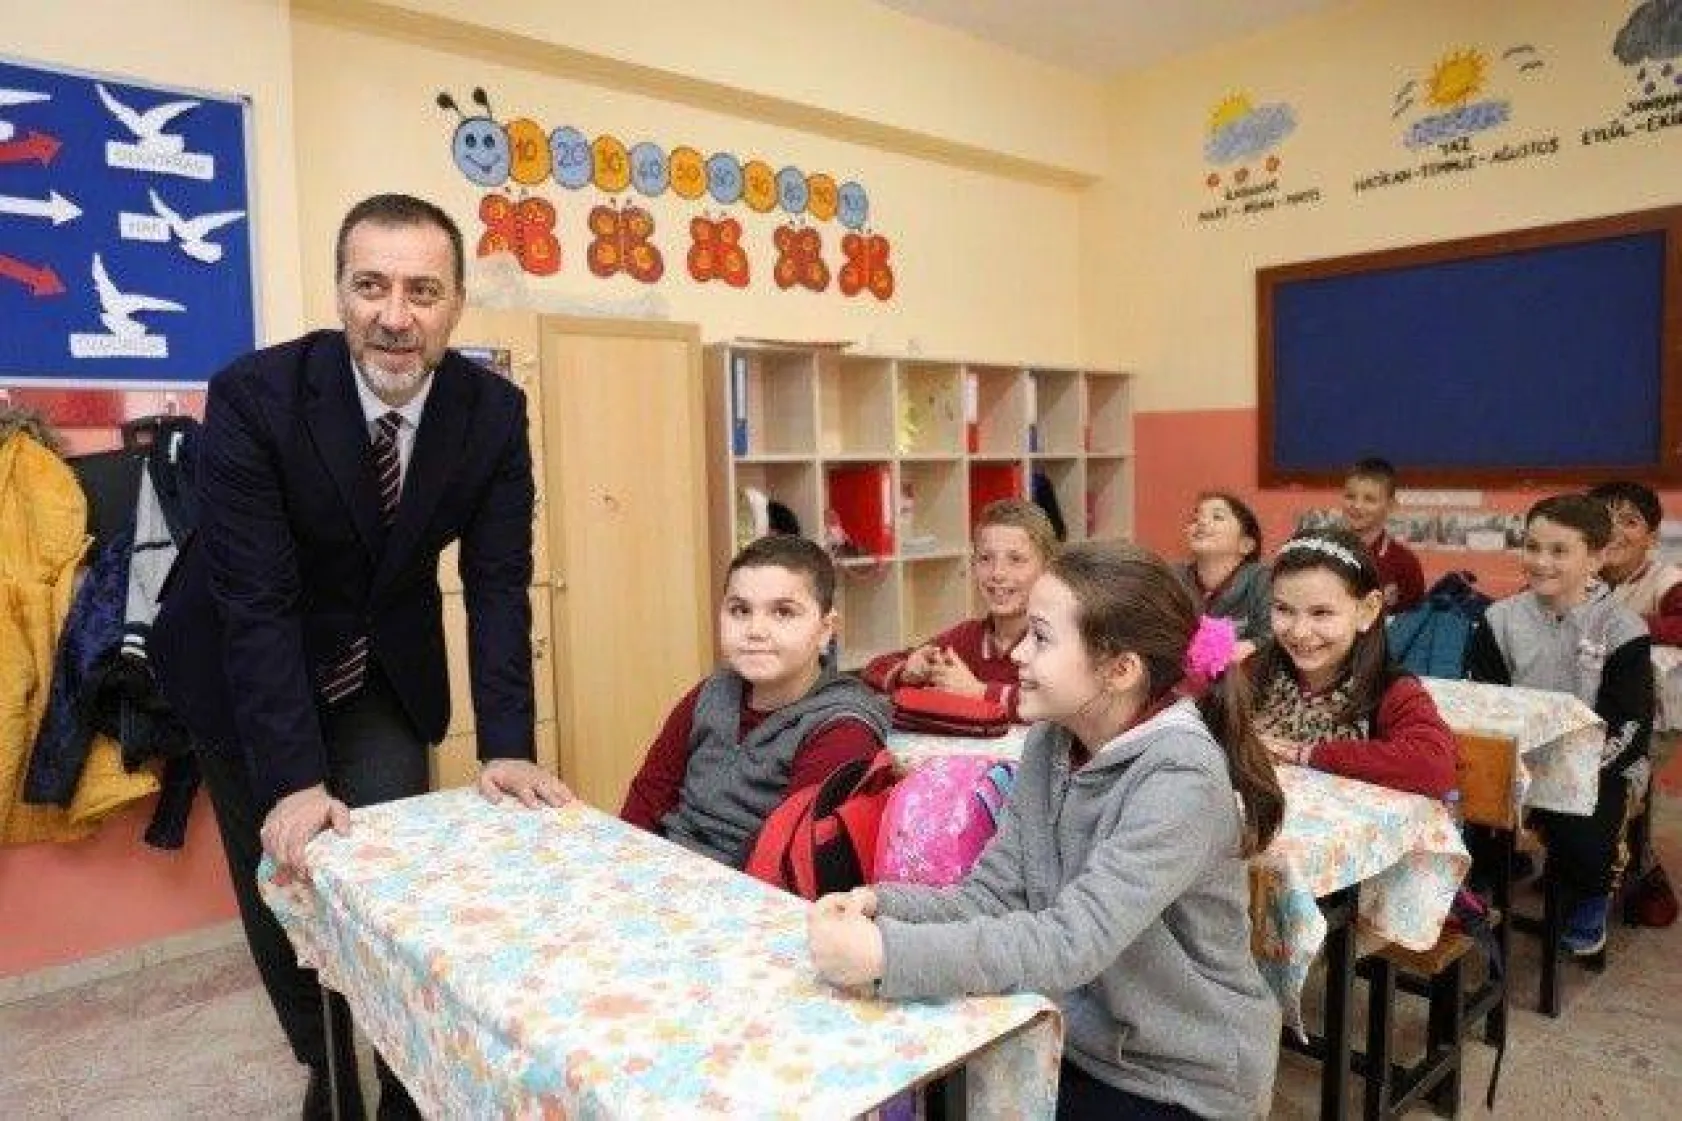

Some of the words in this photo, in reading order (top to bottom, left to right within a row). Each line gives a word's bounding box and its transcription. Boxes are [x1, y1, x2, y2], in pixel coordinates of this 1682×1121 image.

[516, 138, 538, 161] 10
[557, 141, 586, 168] 20
[1437, 136, 1471, 155] YAZ
